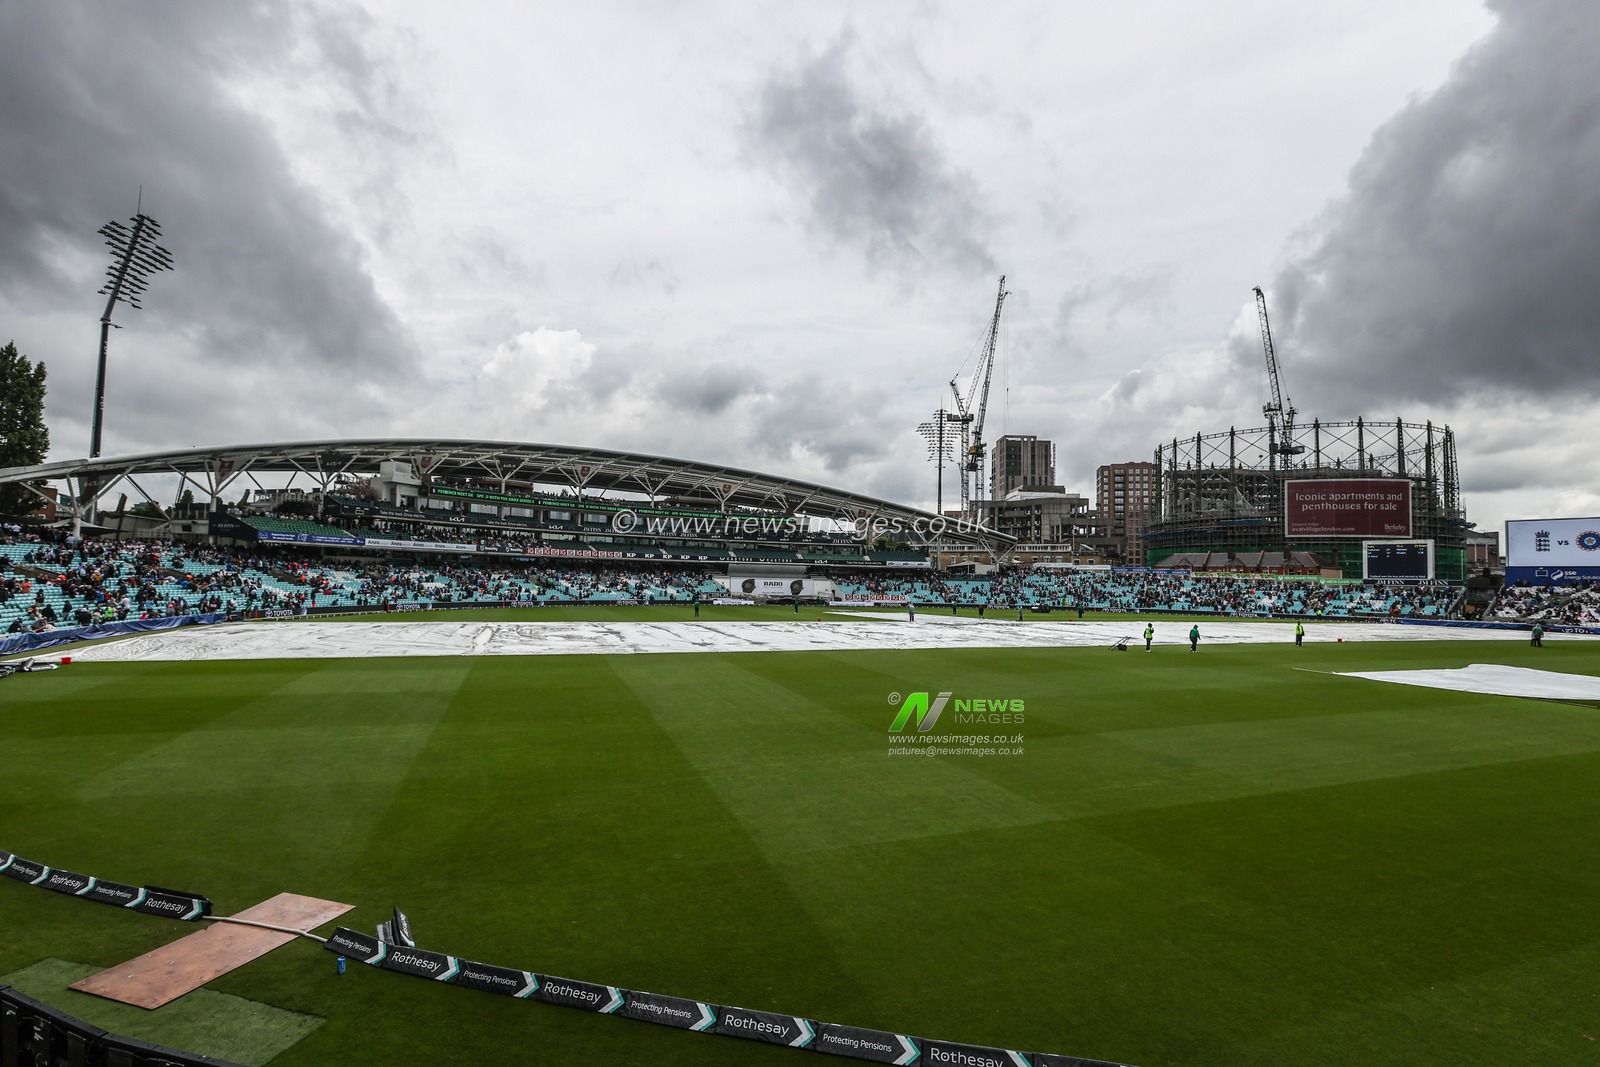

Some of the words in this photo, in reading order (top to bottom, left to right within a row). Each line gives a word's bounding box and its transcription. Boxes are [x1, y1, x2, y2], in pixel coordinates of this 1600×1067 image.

[1296, 492, 1326, 500] Iconic
[1328, 492, 1384, 501] apartments
[1386, 492, 1402, 500] and
[1302, 502, 1361, 511] penthouses
[1384, 524, 1406, 532] Berkeley
[50, 874, 84, 889] Rothesay
[95, 886, 115, 897] Protecting
[115, 889, 132, 899] Pensions
[145, 898, 187, 914] Rothesay
[333, 934, 354, 950] Protecting
[352, 940, 371, 954] Pensions
[391, 951, 441, 973] Rothesay
[463, 970, 492, 984] Protecting
[492, 974, 517, 987] Pensions
[544, 982, 602, 1004] Rothesay
[631, 1000, 662, 1015] Protecting
[664, 1007, 692, 1019] Pensions
[724, 1015, 790, 1038] Rothesay
[823, 1034, 859, 1048] Protecting
[860, 1038, 892, 1052] Pensions
[930, 1047, 1003, 1067] Rothesay
